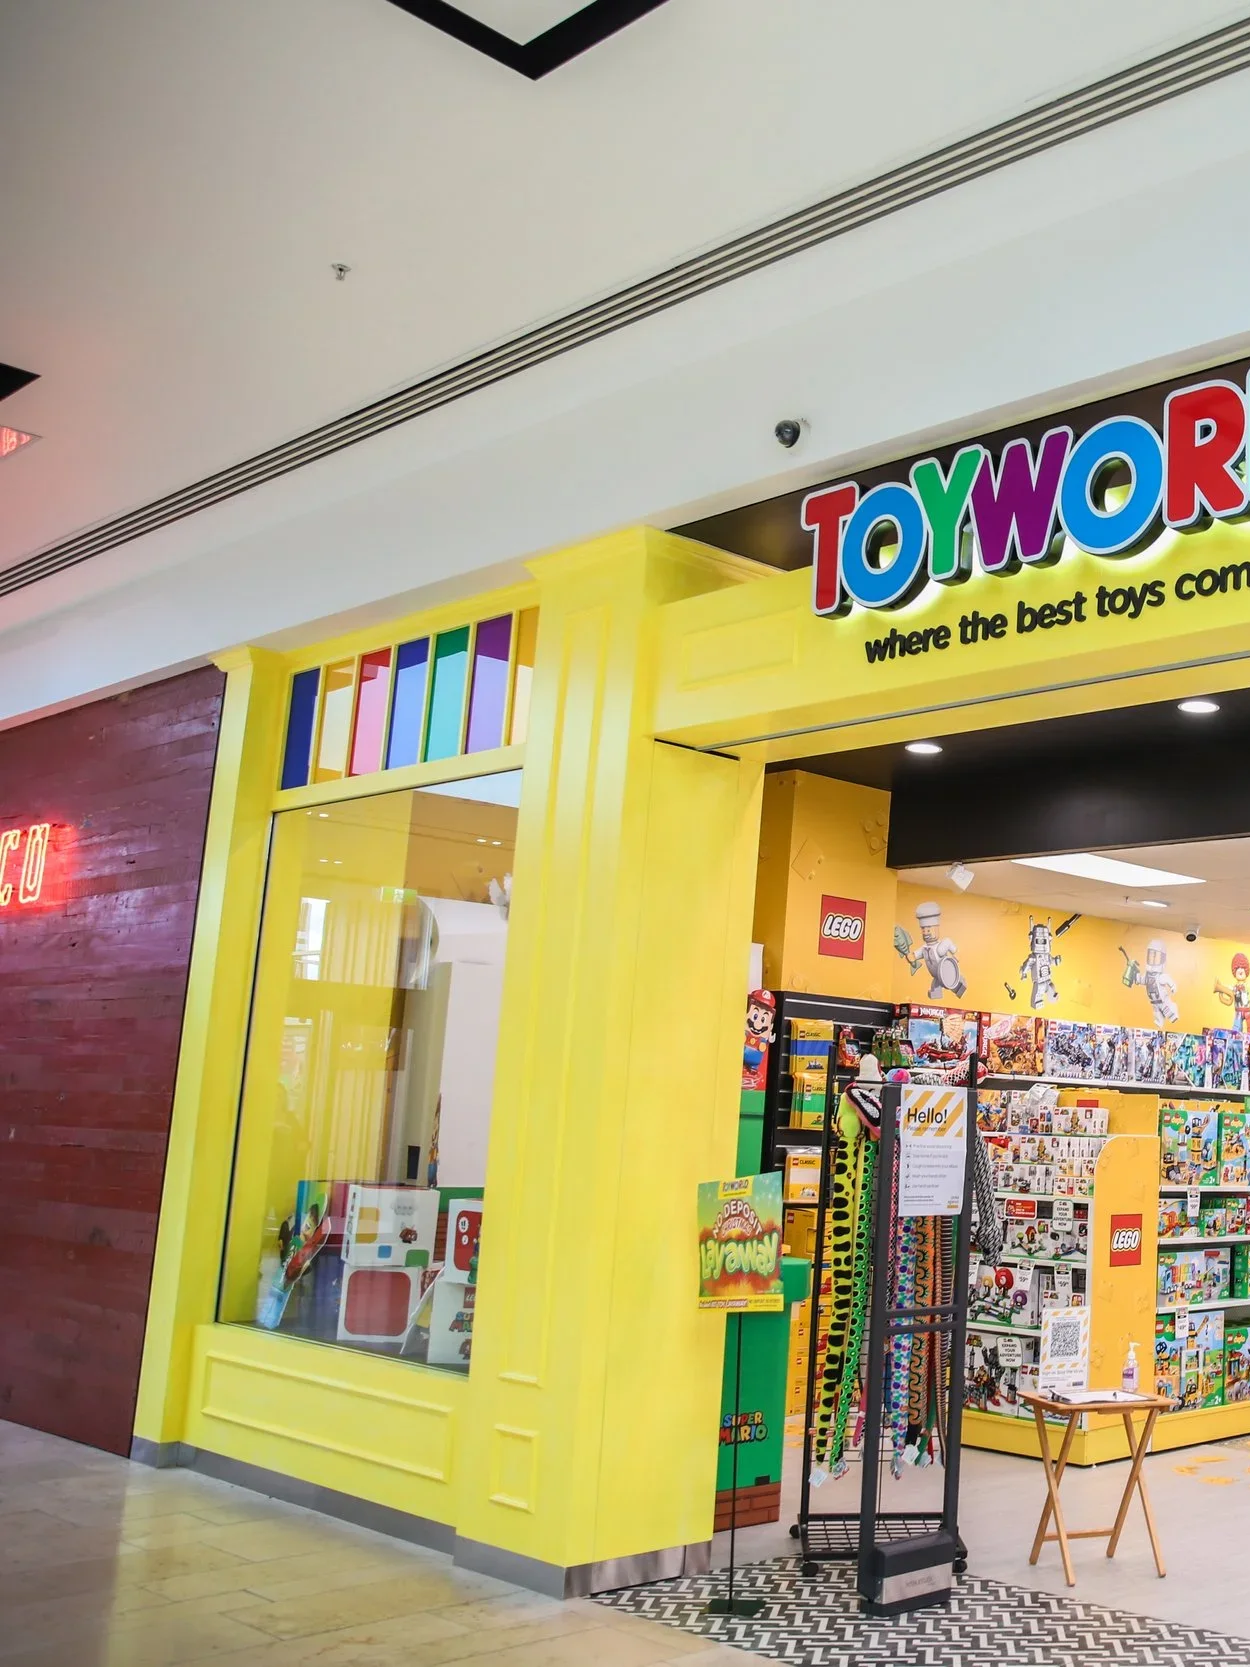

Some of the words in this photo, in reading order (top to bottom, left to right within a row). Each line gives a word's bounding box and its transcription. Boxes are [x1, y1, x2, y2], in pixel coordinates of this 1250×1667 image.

[864, 622, 951, 665] where
[958, 611, 1009, 646] the
[1016, 592, 1089, 634] best
[1095, 574, 1167, 618] toys
[821, 912, 863, 942] LEGO
[906, 1107, 949, 1124] Hello!
[712, 1212, 723, 1239] NO
[723, 1200, 763, 1237] DEPOSIT
[1112, 1227, 1141, 1253] LEGO
[700, 1232, 779, 1280] Layaway
[723, 1411, 763, 1428] SUPER
